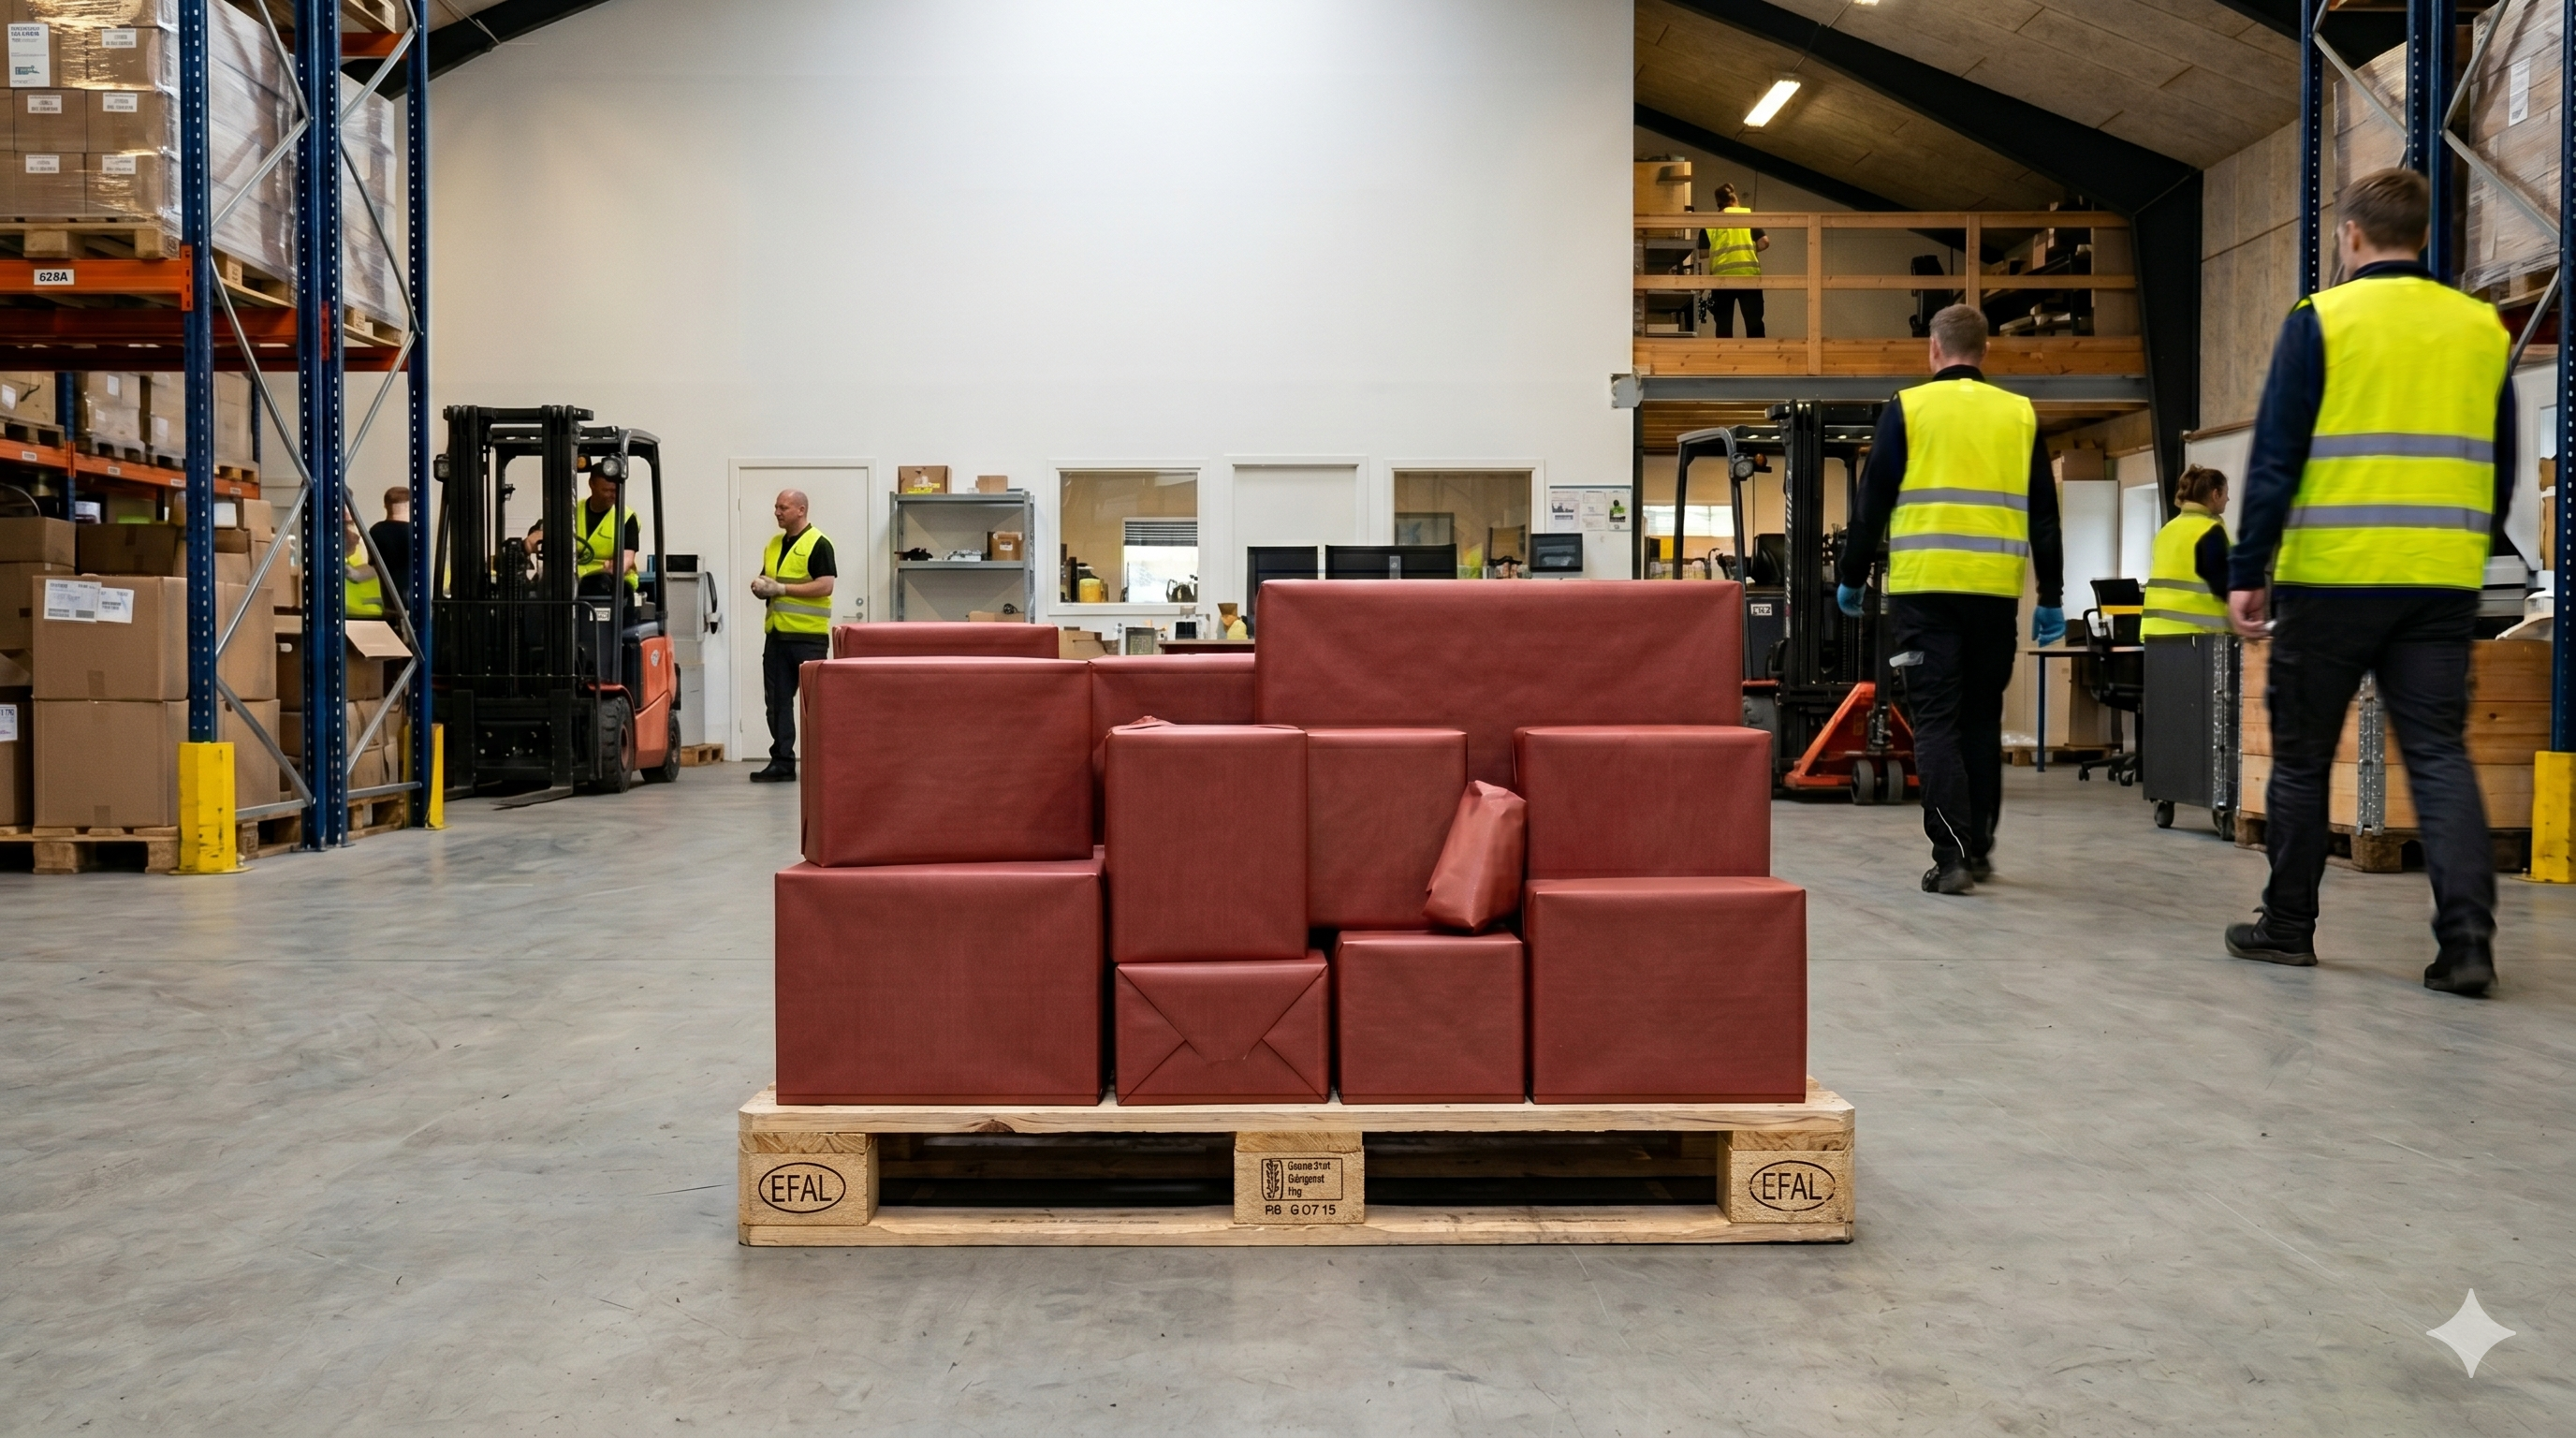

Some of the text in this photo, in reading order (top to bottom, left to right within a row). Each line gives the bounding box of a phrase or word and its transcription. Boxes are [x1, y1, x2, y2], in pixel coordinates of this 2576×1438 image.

[39, 271, 68, 282] 628A
[771, 1174, 832, 1202] EFAL
[1763, 1172, 1822, 1200] EFAL
